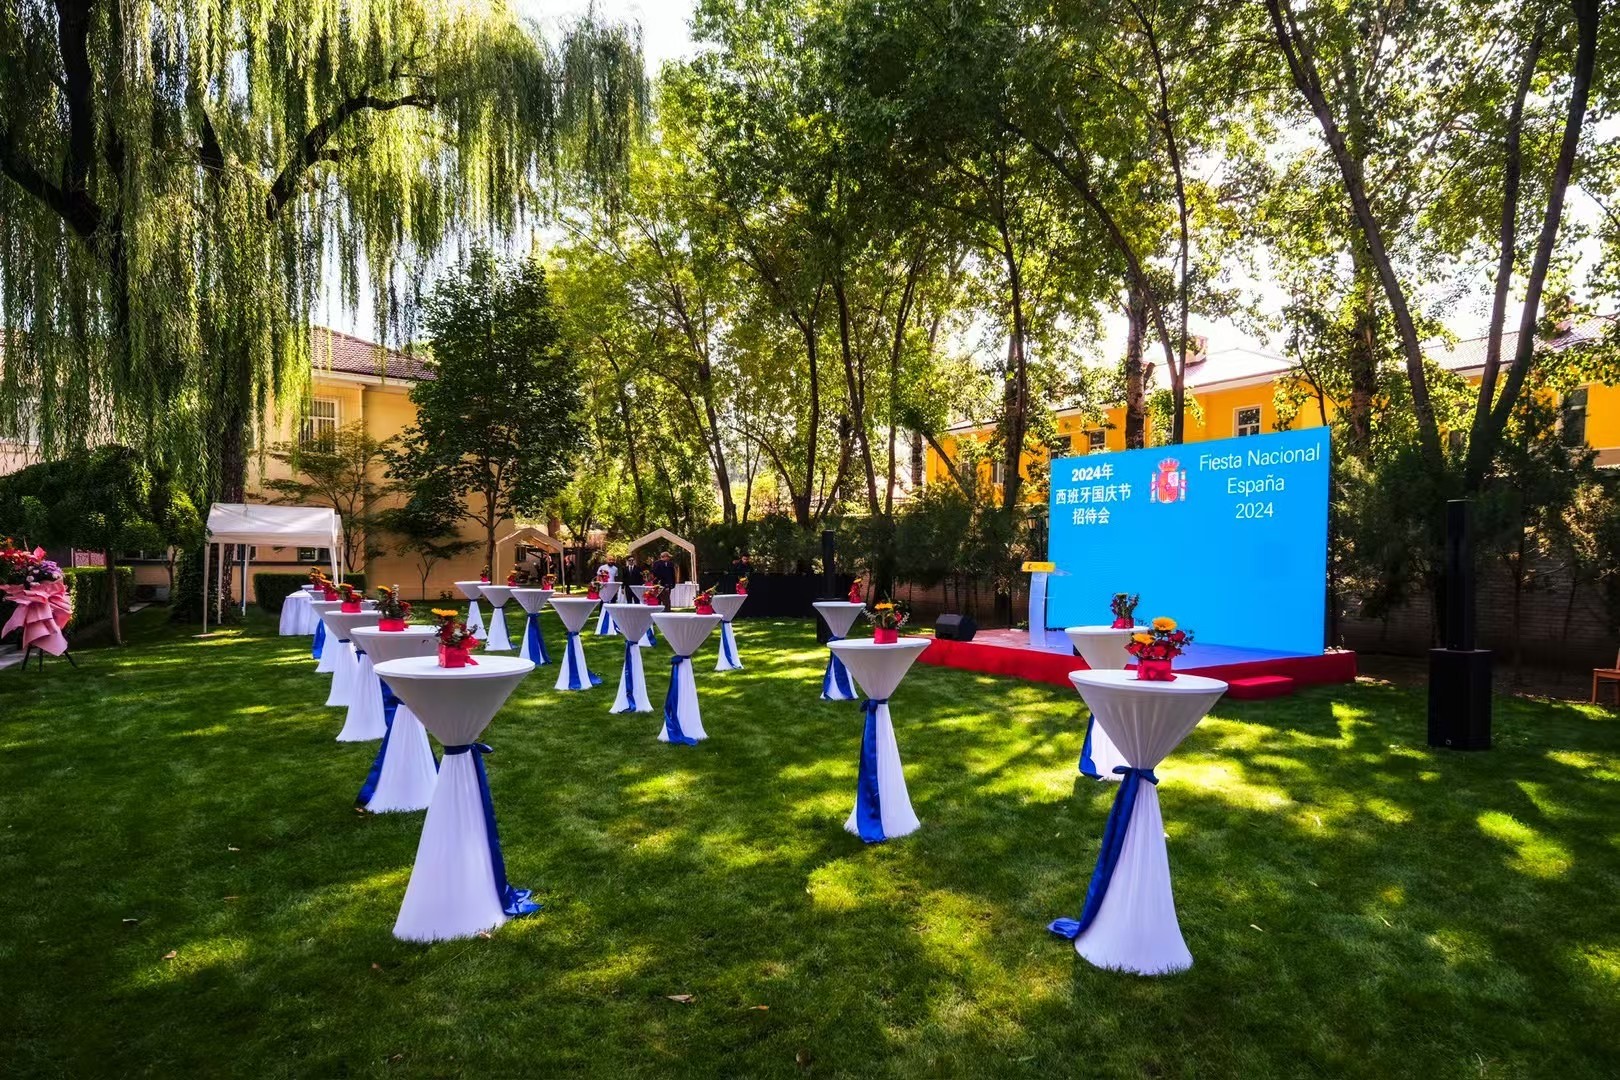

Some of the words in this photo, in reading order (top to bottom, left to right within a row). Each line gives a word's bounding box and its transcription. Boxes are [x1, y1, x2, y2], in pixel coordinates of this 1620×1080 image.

[1199, 452, 1242, 471] Fiesta
[1247, 442, 1321, 467] Nacional
[1071, 462, 1114, 482] 2024年
[1055, 482, 1132, 505] 西班牙国庆节
[1227, 474, 1285, 497] España
[1072, 506, 1111, 525] 招待会
[1235, 501, 1274, 519] 2024
